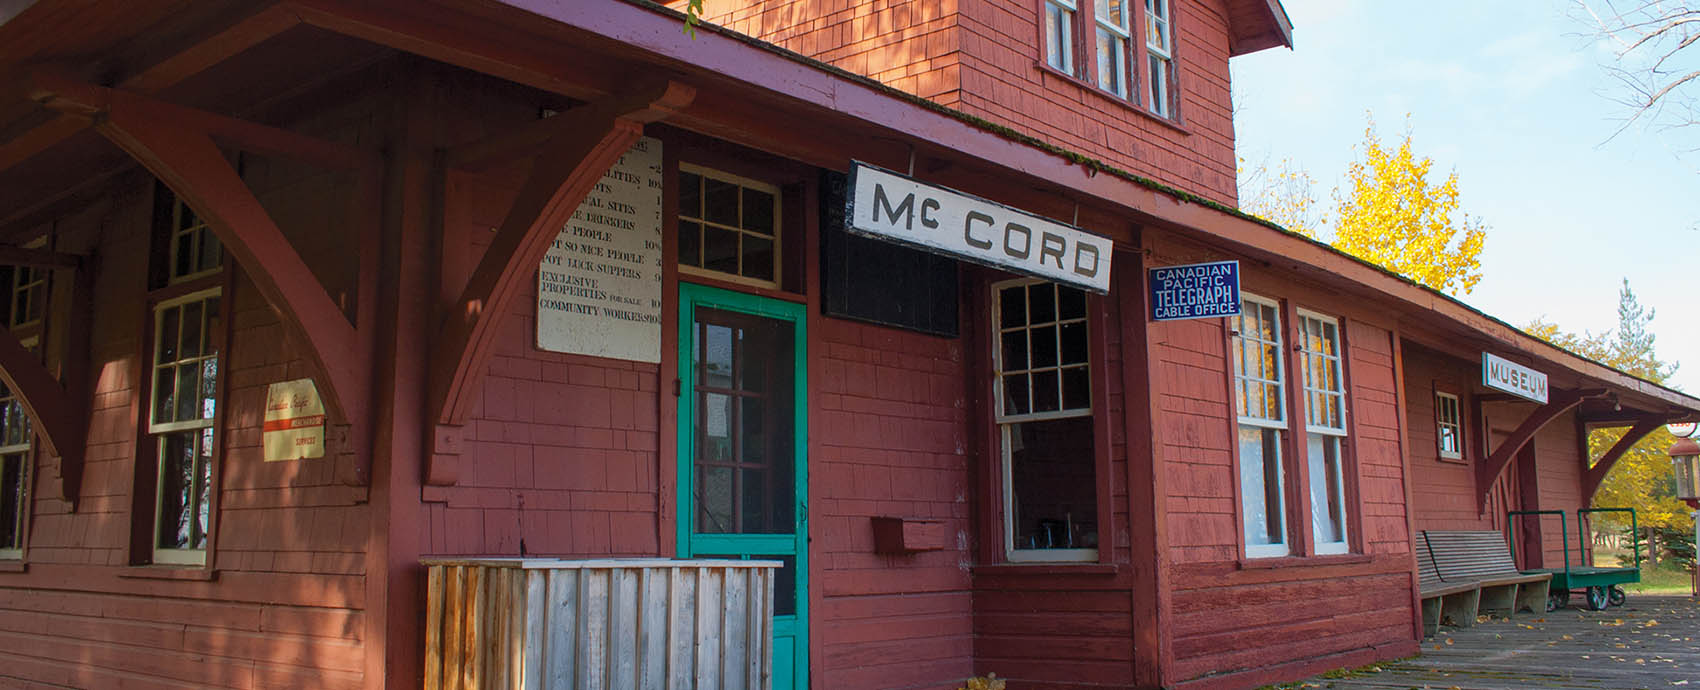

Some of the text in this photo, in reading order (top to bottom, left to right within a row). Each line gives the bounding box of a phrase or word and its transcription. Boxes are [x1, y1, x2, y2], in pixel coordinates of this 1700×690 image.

[608, 201, 636, 215] SITES
[586, 212, 636, 231] DRINKERS
[573, 226, 612, 242] PEOPLE
[964, 210, 1099, 278] CORD
[565, 242, 577, 253] SO
[580, 244, 603, 257] NICE
[608, 249, 645, 265] PEOPLE
[568, 258, 594, 272] LUCK
[596, 264, 641, 280] SUPPERS
[1156, 264, 1231, 281] CANADIAN
[541, 271, 599, 289] EXCLUSIVE
[1164, 276, 1224, 290] PACIFIC
[541, 281, 607, 301] PROPERTIES
[624, 297, 641, 306] SALE
[1156, 285, 1232, 307] TELEGRAPH
[540, 298, 600, 316] COMMUNITY
[603, 307, 650, 323] WORKERS
[1155, 302, 1236, 318] CABLE OFFICE
[1489, 361, 1546, 397] MUSEUM
